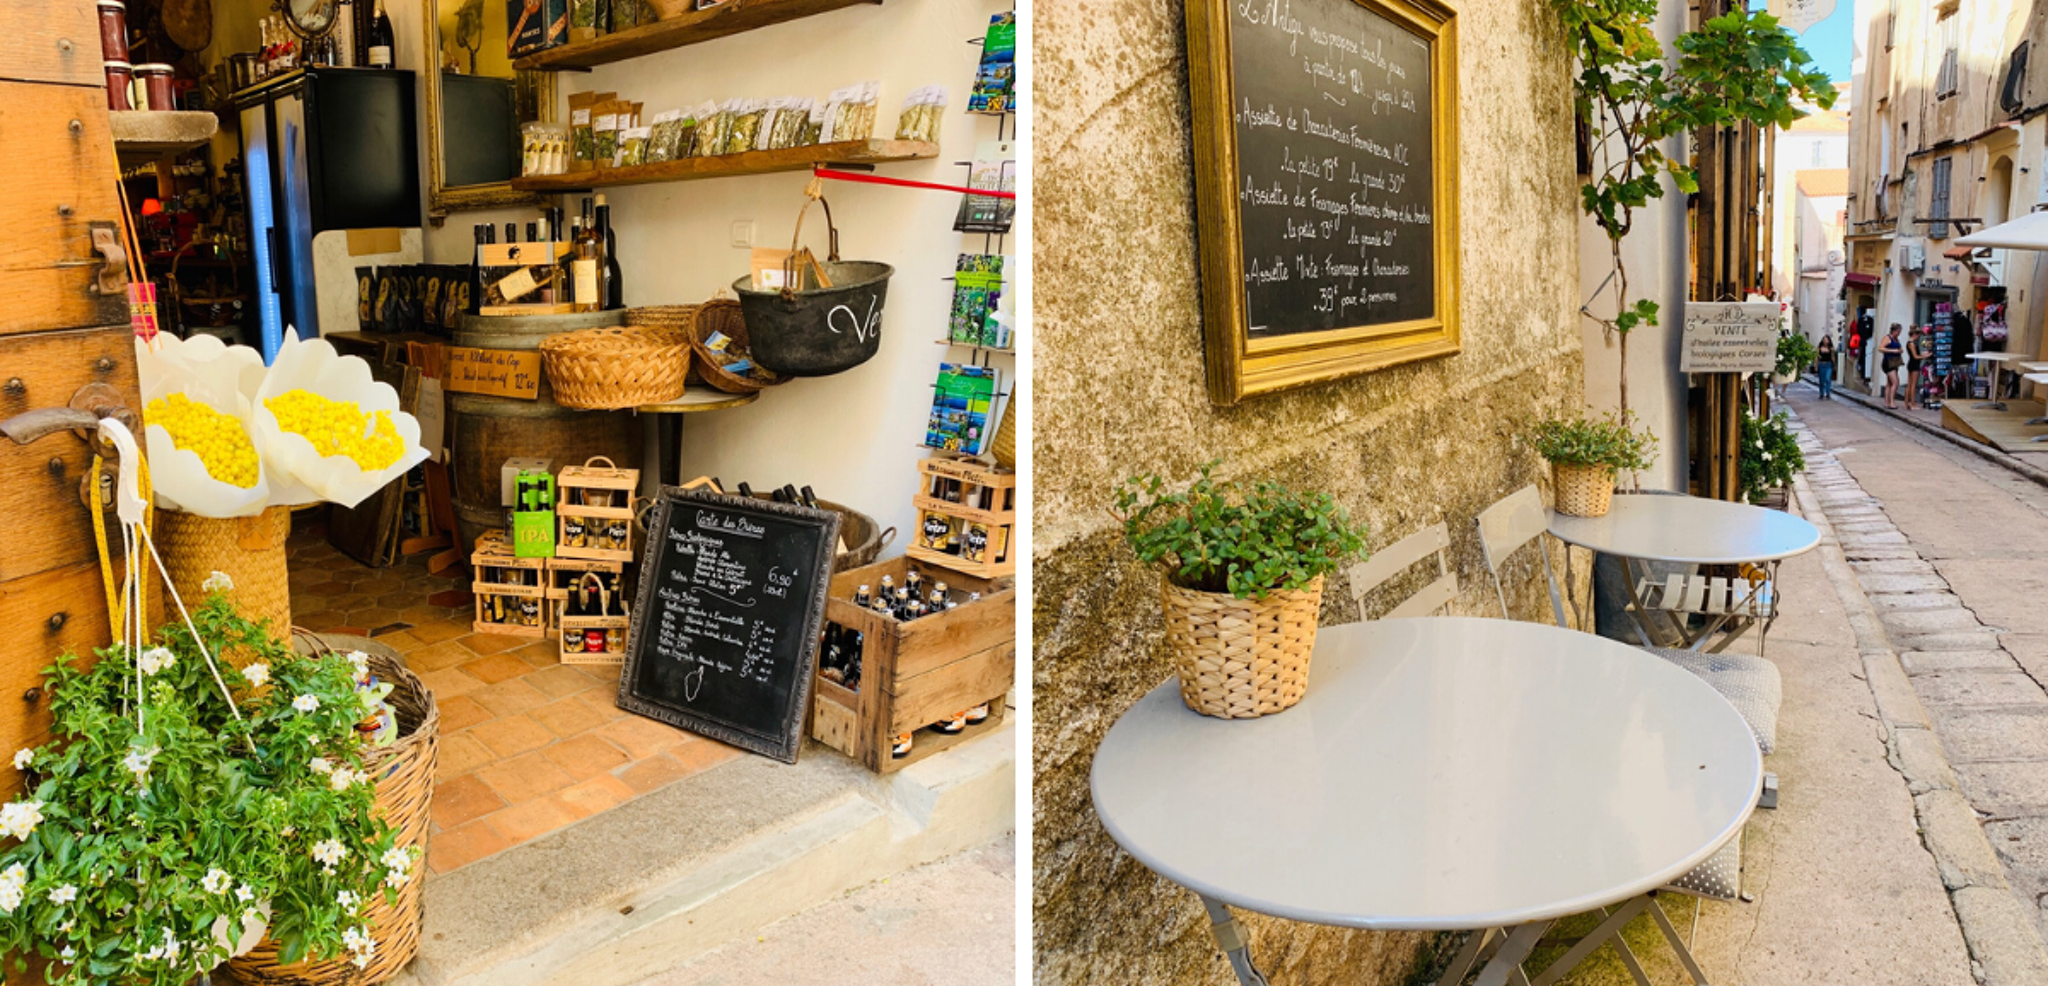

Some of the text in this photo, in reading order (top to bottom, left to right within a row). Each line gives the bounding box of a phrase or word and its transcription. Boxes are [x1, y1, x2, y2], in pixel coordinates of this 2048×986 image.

[1243, 97, 1282, 130] Assiette
[1286, 106, 1297, 131] de
[1245, 175, 1289, 207] Assiette
[1293, 185, 1306, 207] de
[1310, 187, 1349, 231] Fromages
[1250, 257, 1289, 287] Assiette
[1324, 253, 1359, 290] Fromages
[1713, 325, 1748, 336] VENTE
[696, 509, 719, 528] Carte
[520, 528, 551, 544] IPA
